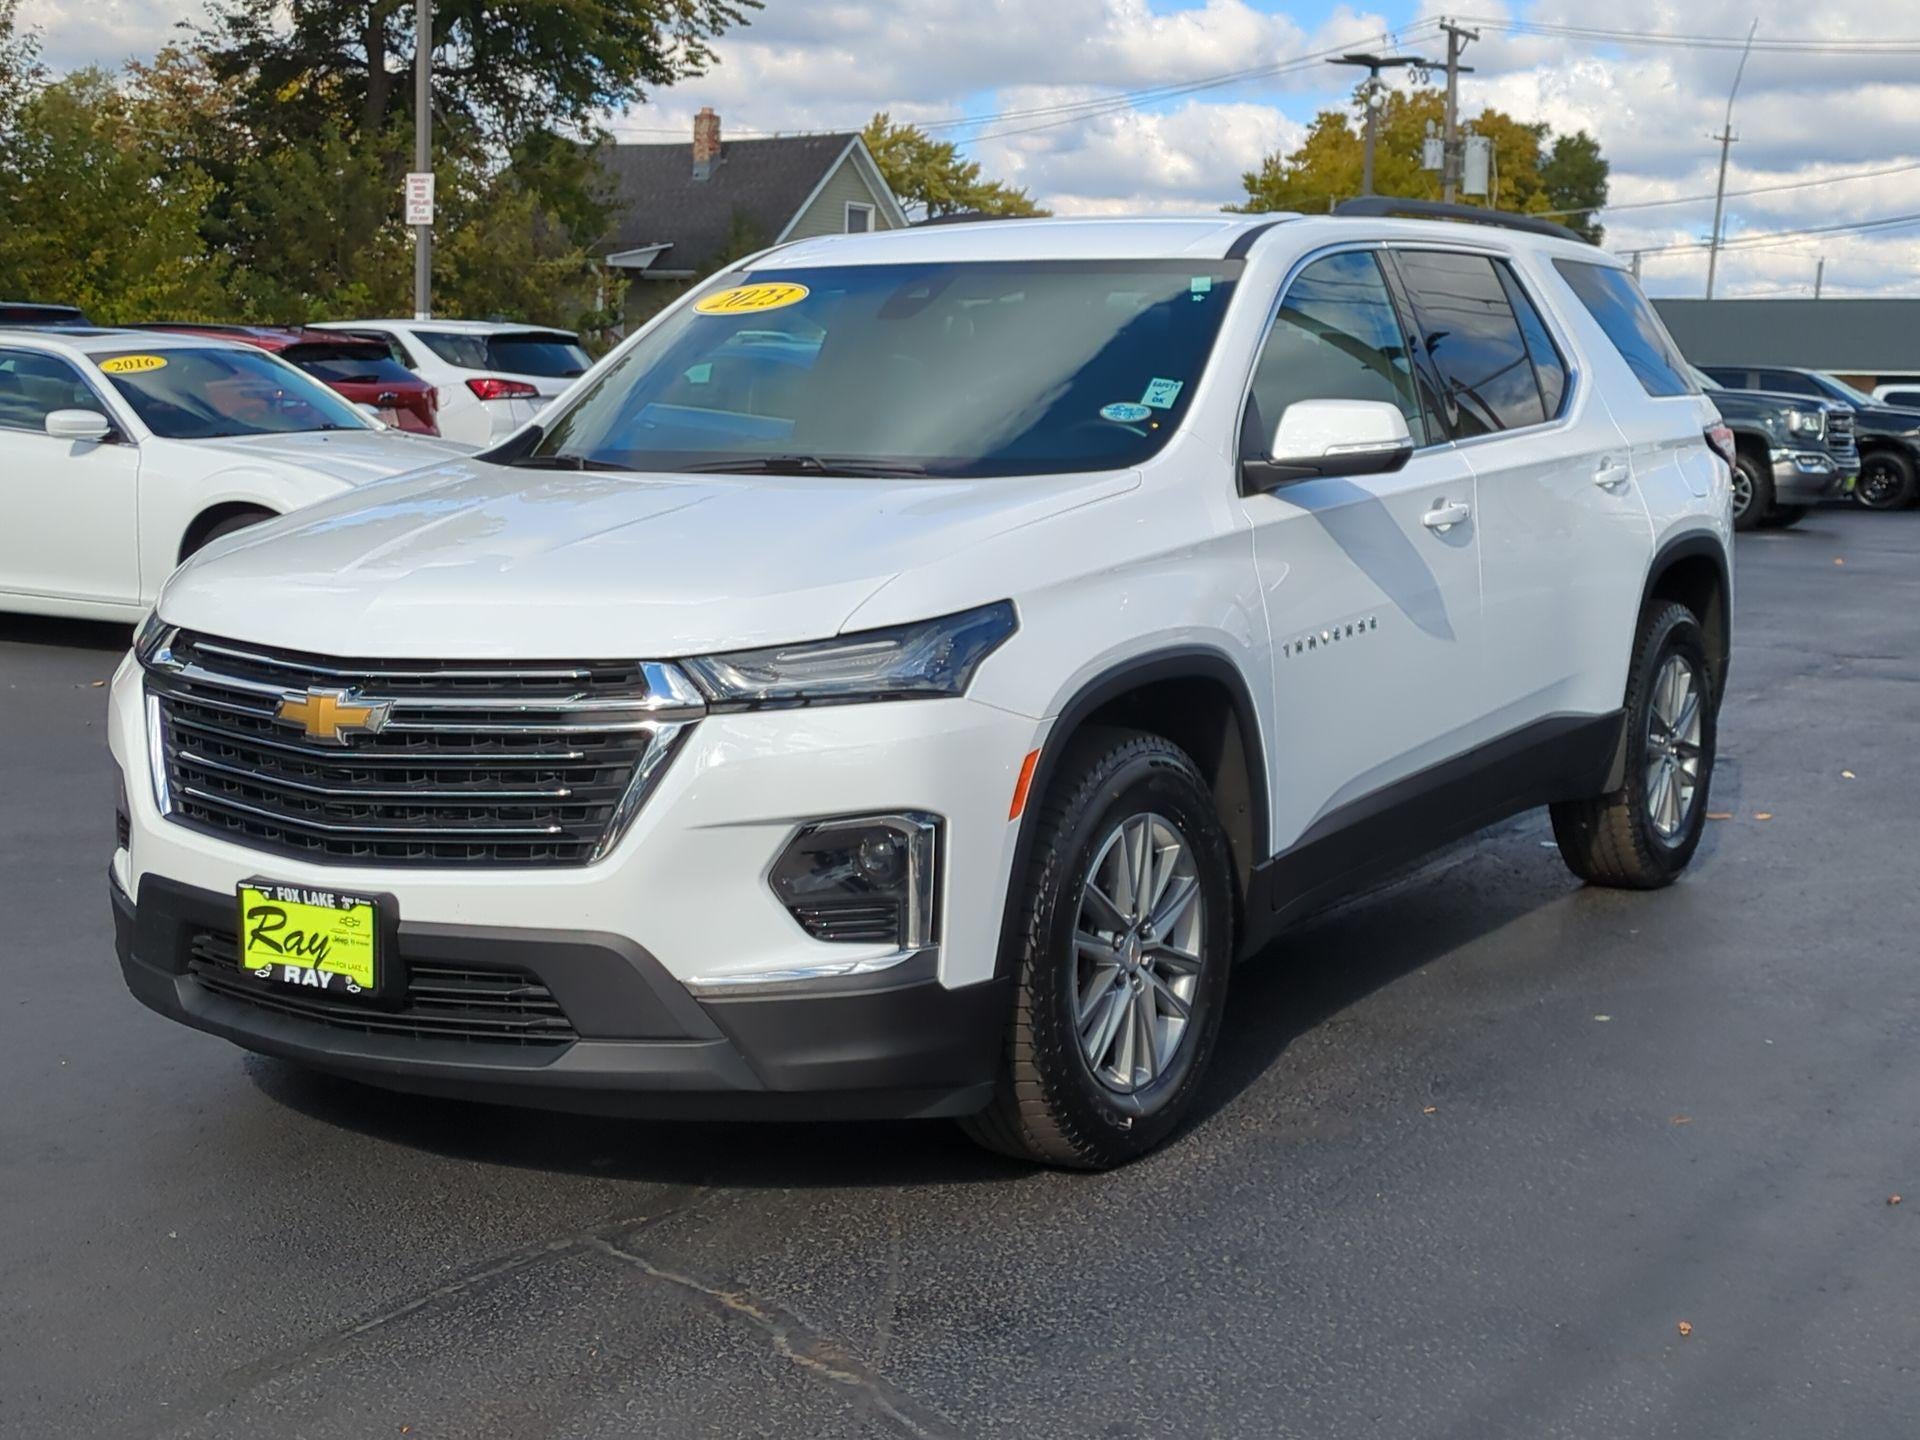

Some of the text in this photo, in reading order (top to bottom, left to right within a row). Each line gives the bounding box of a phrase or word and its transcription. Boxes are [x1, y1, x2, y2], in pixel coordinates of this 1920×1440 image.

[703, 288, 796, 309] 2023
[112, 358, 155, 371] 2016
[1152, 381, 1179, 390] SAFETY
[1282, 616, 1377, 658] TRAVERSE
[276, 886, 299, 903] FOX
[302, 889, 336, 909] LAKE
[247, 906, 331, 969] Ray
[284, 965, 333, 989] RAY
